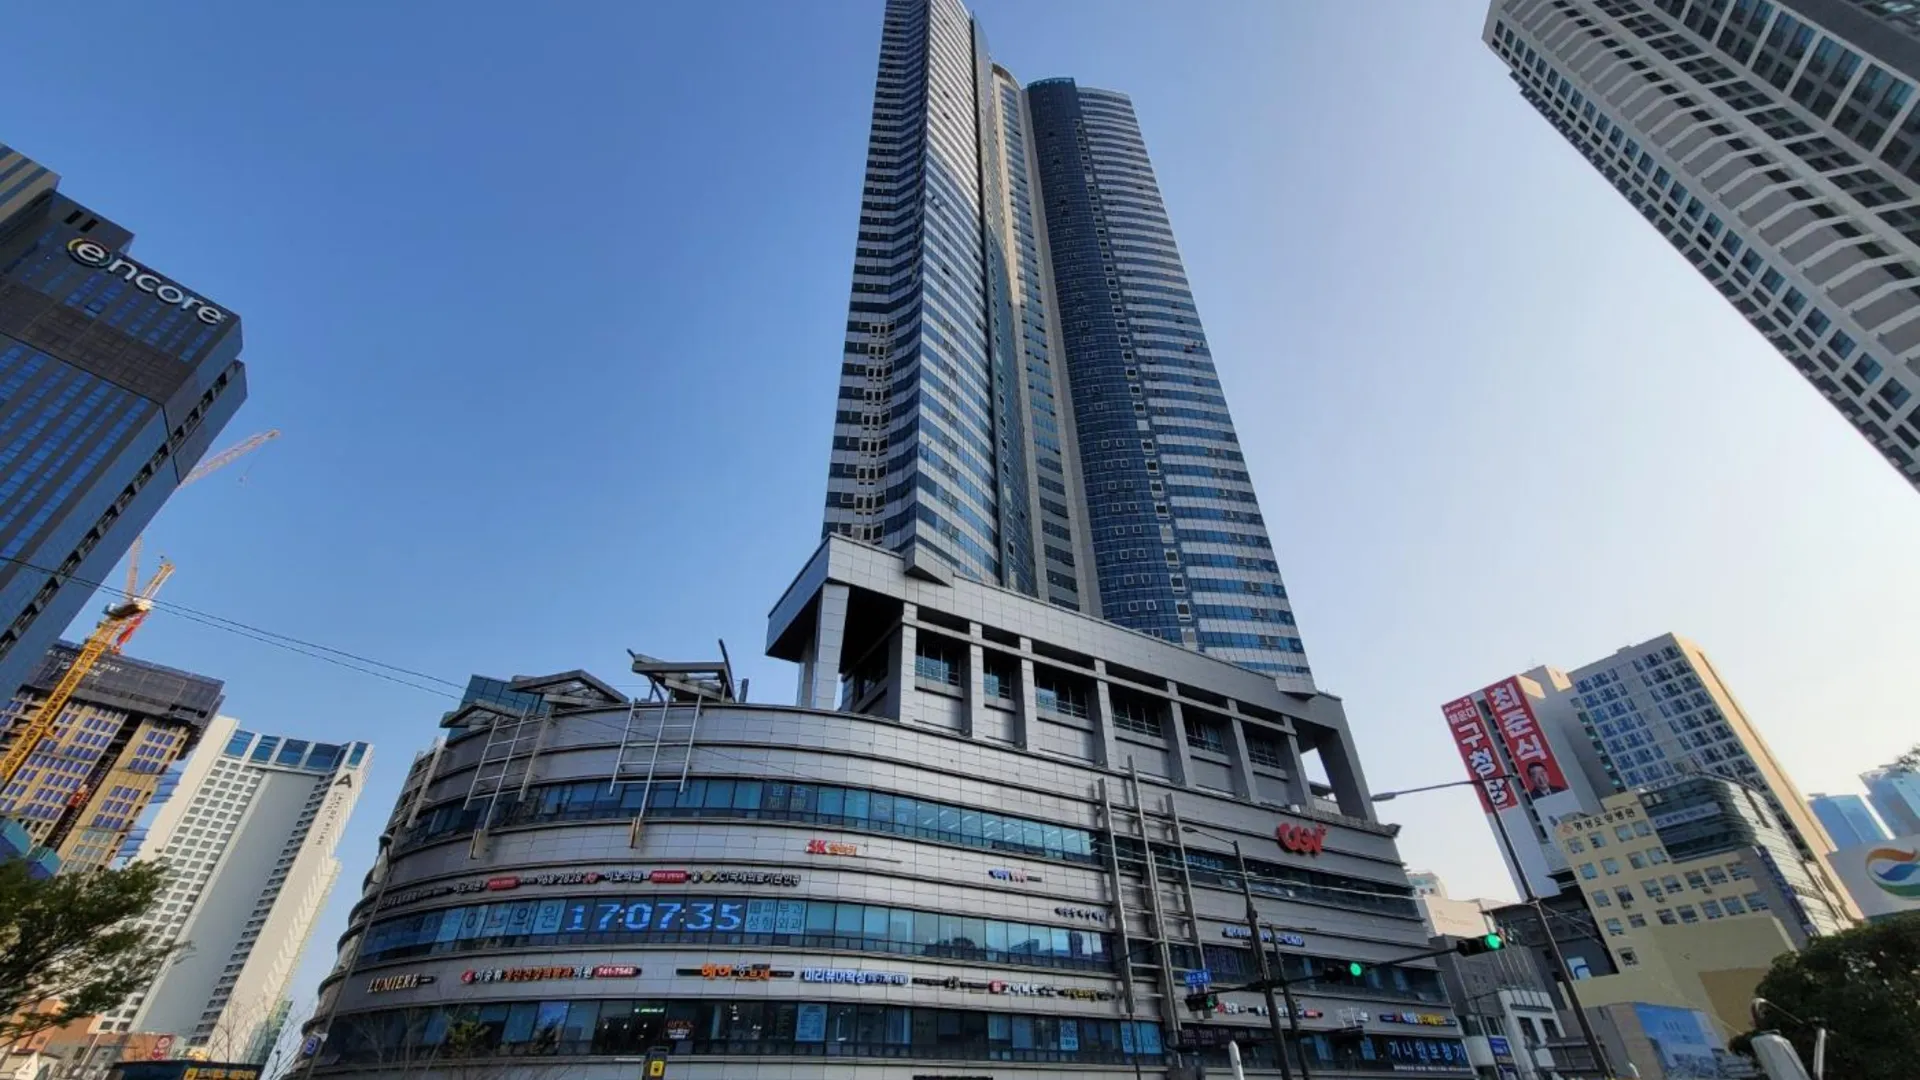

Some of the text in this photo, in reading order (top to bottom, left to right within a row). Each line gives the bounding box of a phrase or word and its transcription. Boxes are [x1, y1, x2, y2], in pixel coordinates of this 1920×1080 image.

[75, 241, 223, 325] encore
[1491, 683, 1548, 761] 최준식
[1457, 721, 1508, 806] 구청장
[565, 902, 744, 932] 17:07:35
[367, 974, 418, 994] LUMIERE
